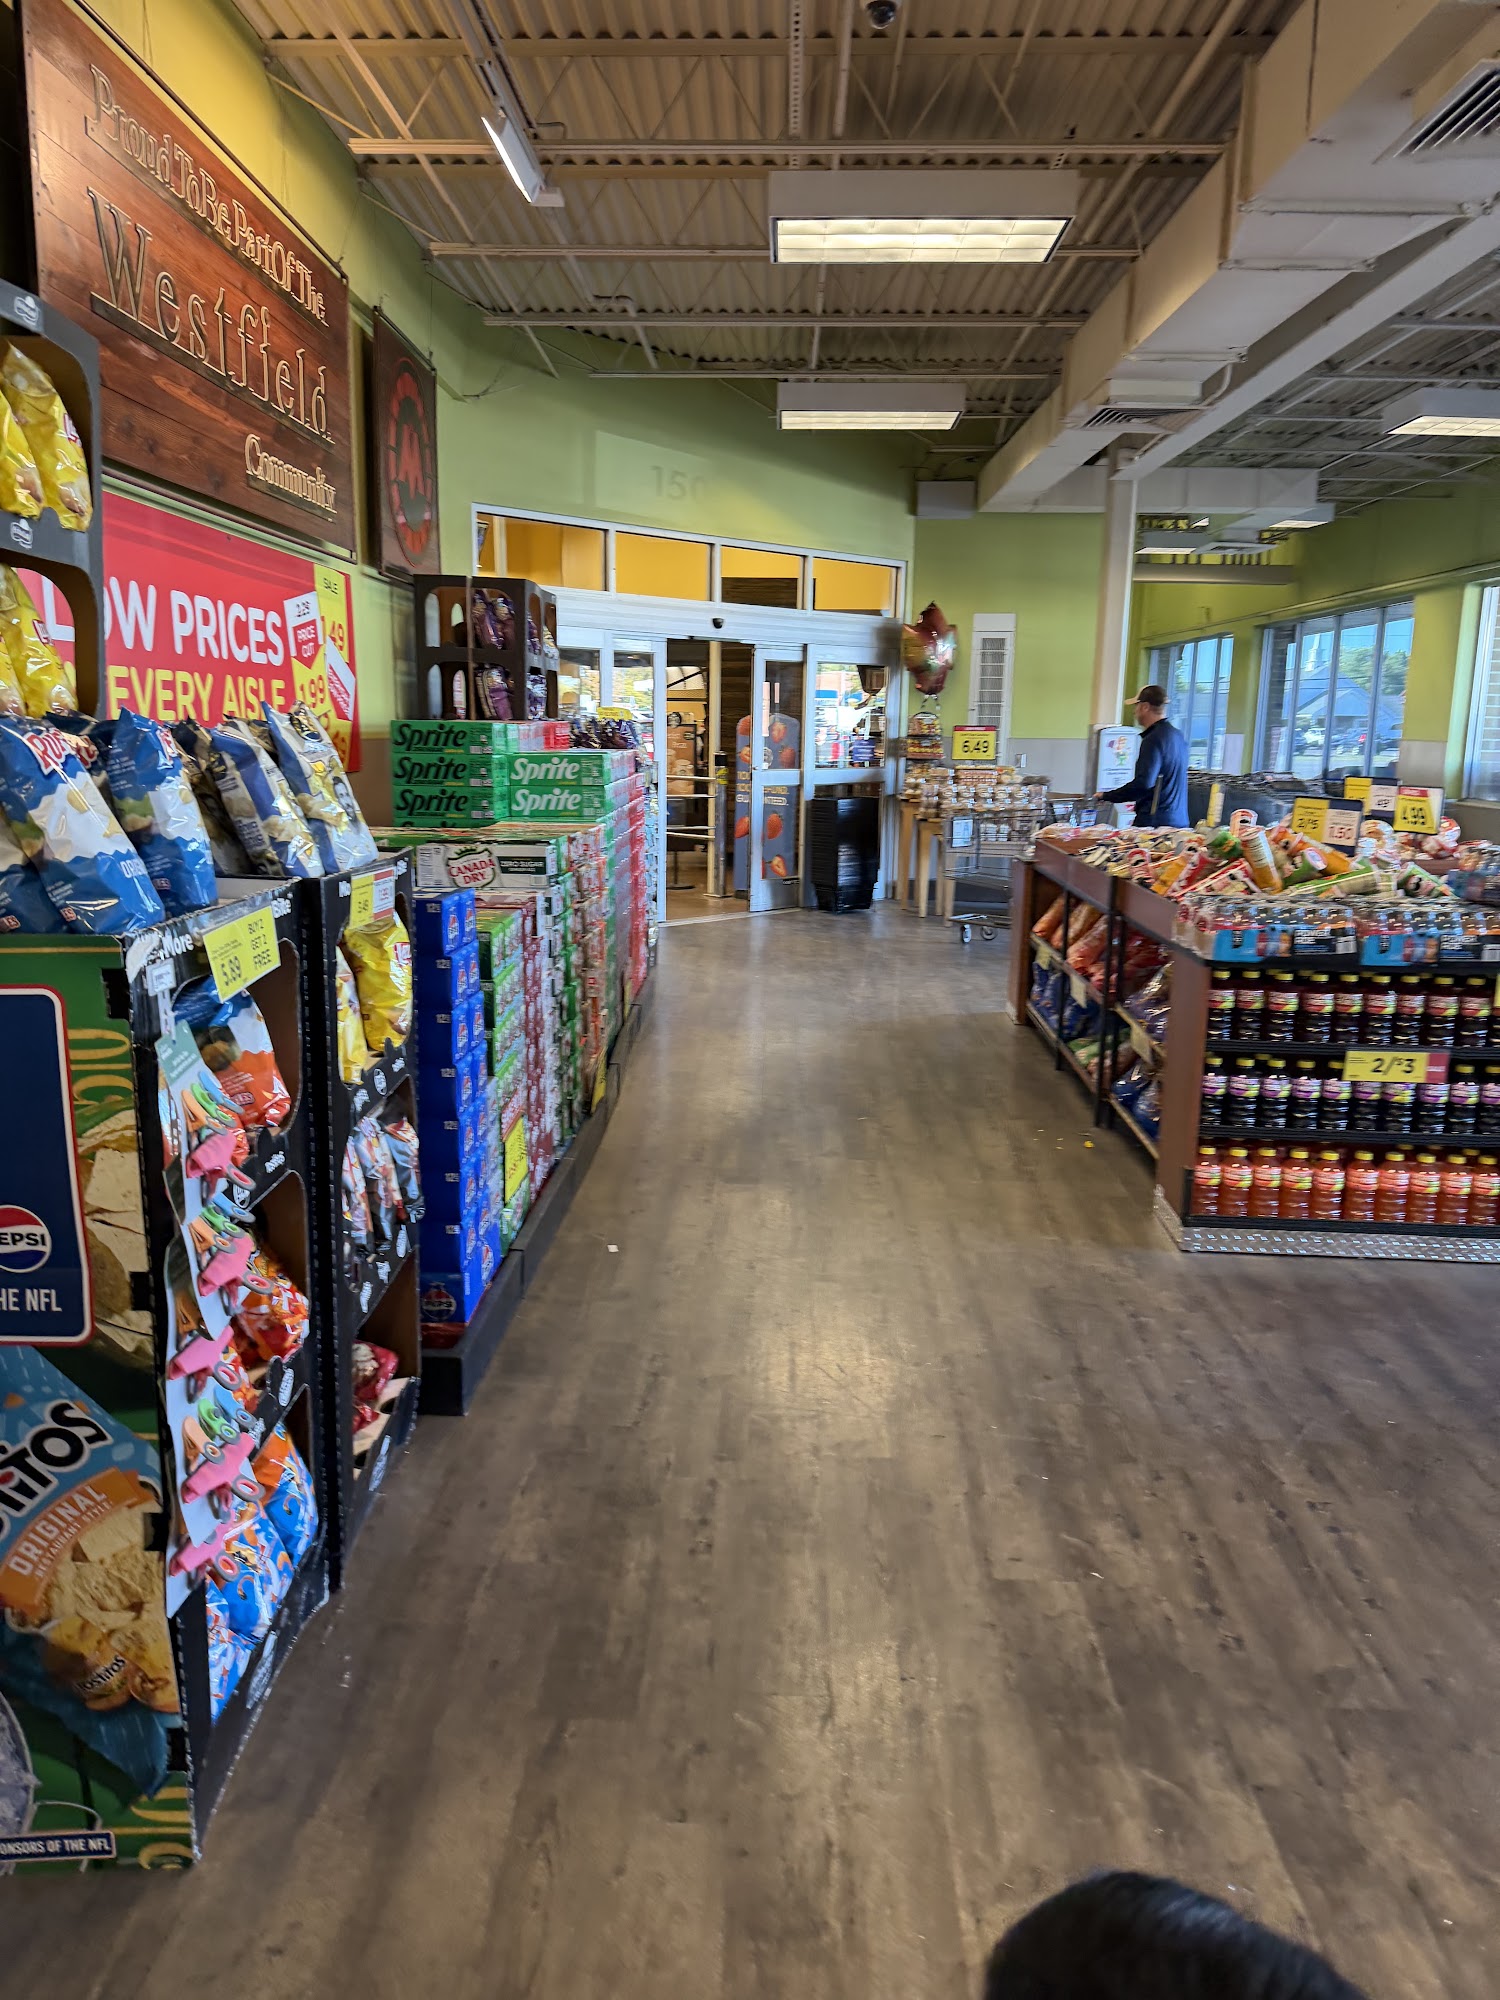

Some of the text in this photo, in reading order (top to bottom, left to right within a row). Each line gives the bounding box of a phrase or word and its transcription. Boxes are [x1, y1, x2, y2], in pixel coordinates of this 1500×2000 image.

[89, 64, 328, 327] Proud To Be Part Of The
[87, 186, 334, 441] Westfield
[244, 434, 337, 513] Community
[170, 590, 284, 666] PRICES
[107, 664, 213, 722] EVERY
[393, 723, 467, 752] Sprite
[962, 740, 989, 753] 6.49
[394, 756, 467, 784] Sprite
[511, 757, 580, 784] Sprite
[395, 789, 468, 816] Sprite
[511, 788, 582, 815] Sprite
[448, 859, 497, 878] CANADA
[463, 872, 488, 885] DRY
[0, 1232, 47, 1247] EPSI
[25, 1288, 62, 1312] NFL
[8, 1485, 107, 1577] ORIGINAL
[0, 1836, 111, 1856] ONSORS OF THE NFL
